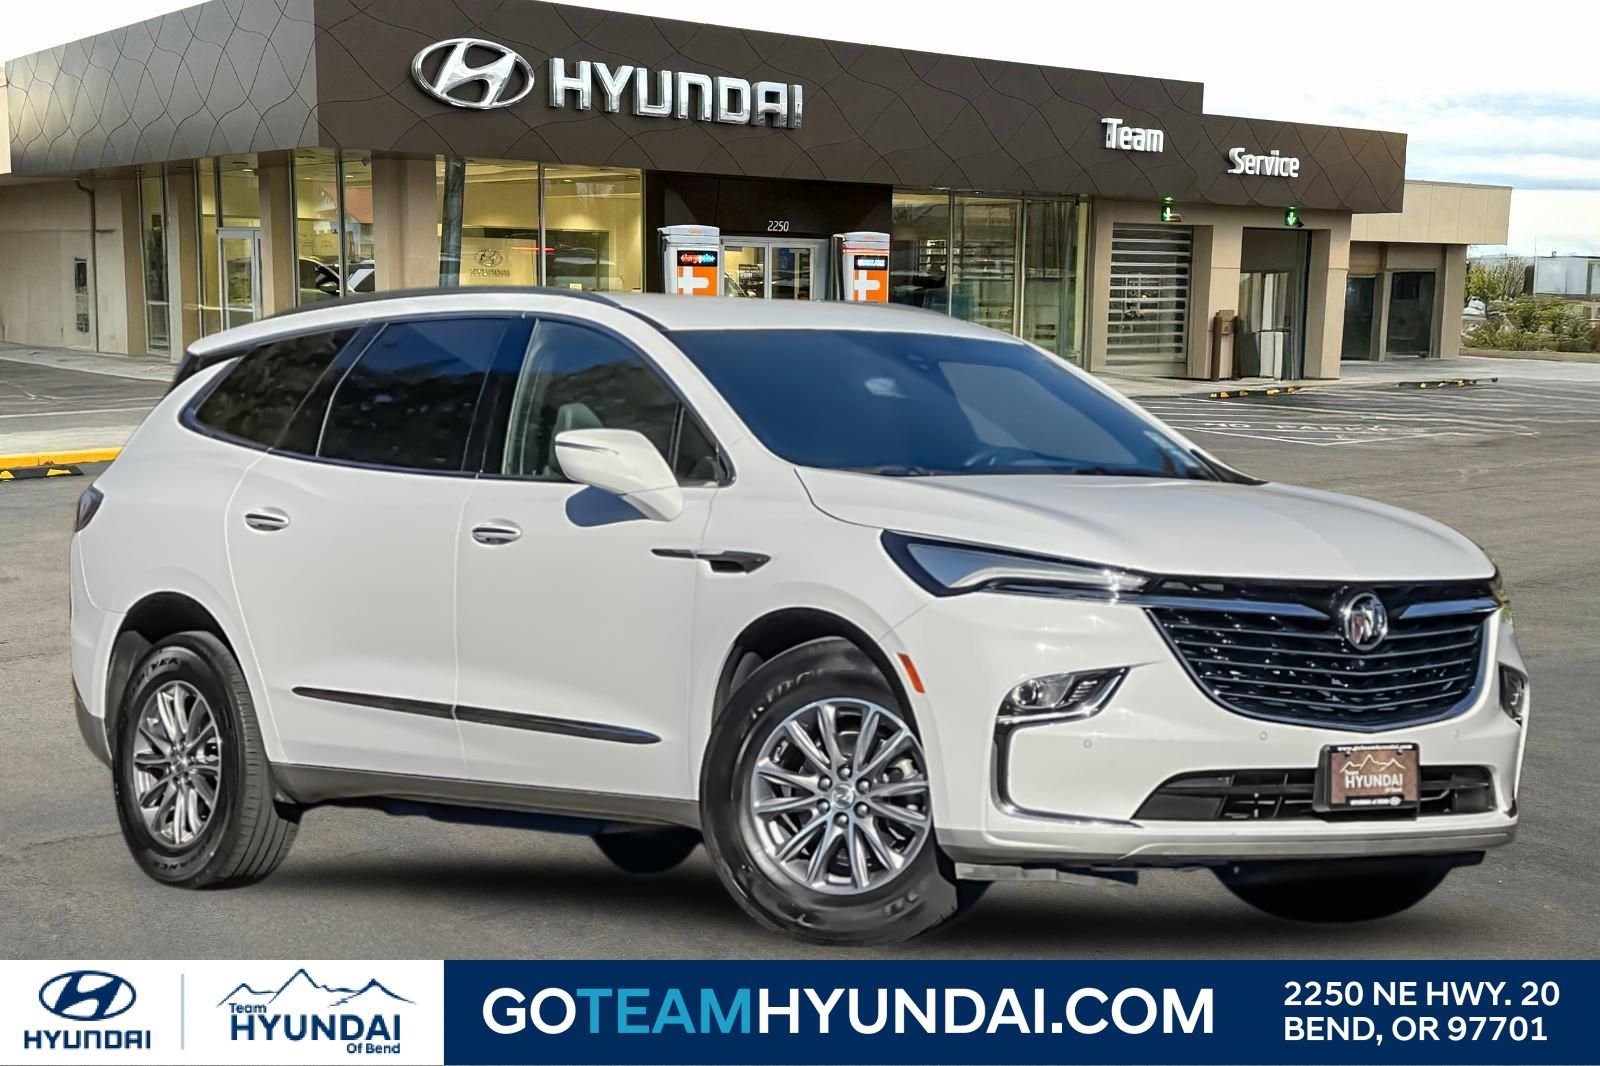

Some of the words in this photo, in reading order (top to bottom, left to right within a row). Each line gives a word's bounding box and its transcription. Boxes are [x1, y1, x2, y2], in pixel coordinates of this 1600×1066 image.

[549, 57, 803, 129] HYUNDAI
[1101, 117, 1164, 153] Team
[1228, 147, 1300, 178] Service
[767, 220, 790, 232] 2250
[1345, 774, 1403, 789] HYUNDAI
